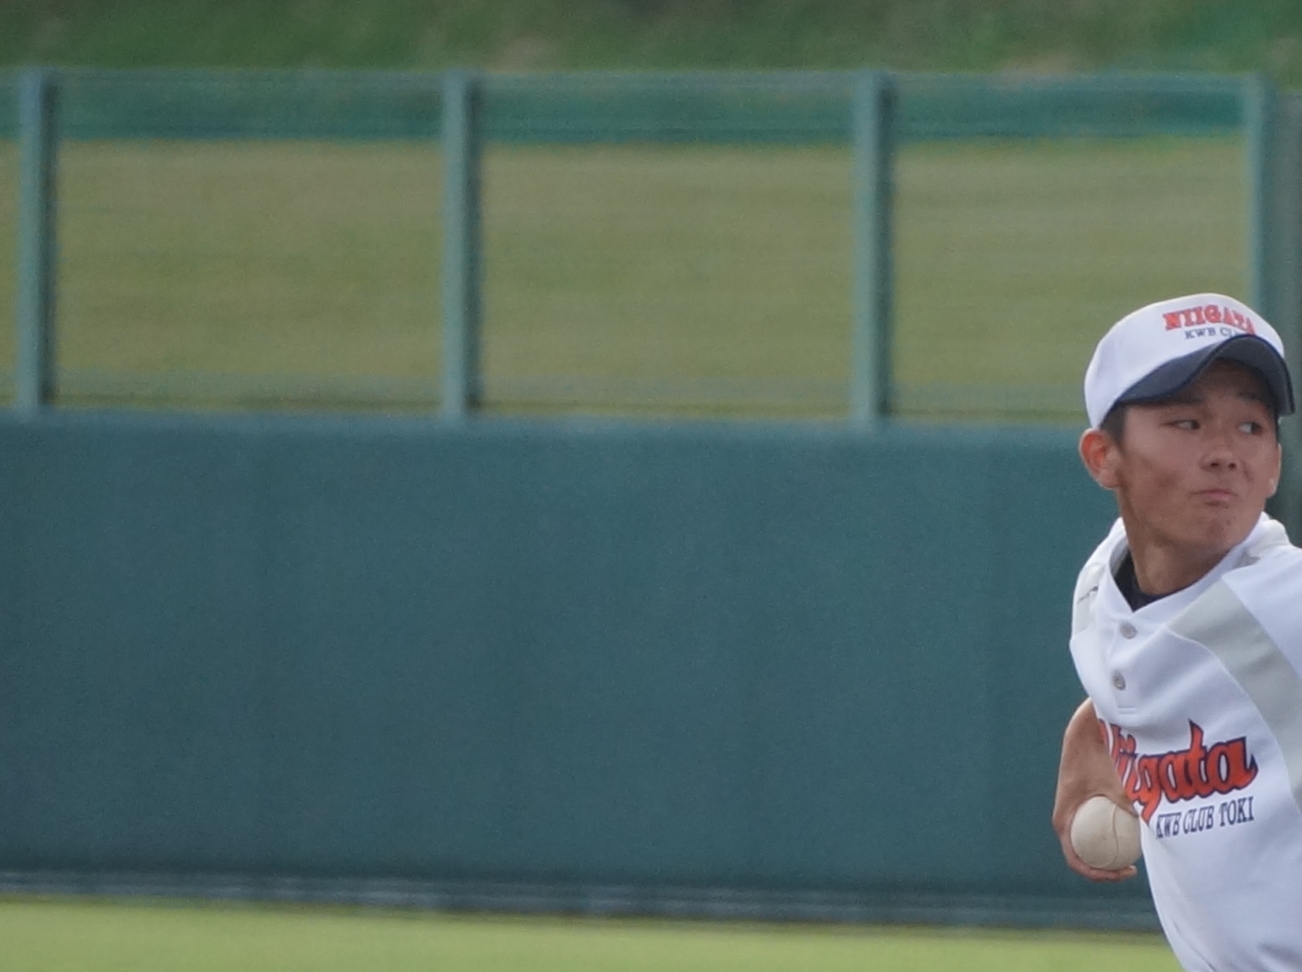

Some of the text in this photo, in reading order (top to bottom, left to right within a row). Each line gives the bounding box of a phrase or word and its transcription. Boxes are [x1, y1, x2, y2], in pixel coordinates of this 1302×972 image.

[1162, 304, 1255, 335] NIIGATA
[1184, 327, 1241, 339] KWB CL
[1156, 797, 1255, 839] KWB CLUB TOKI
